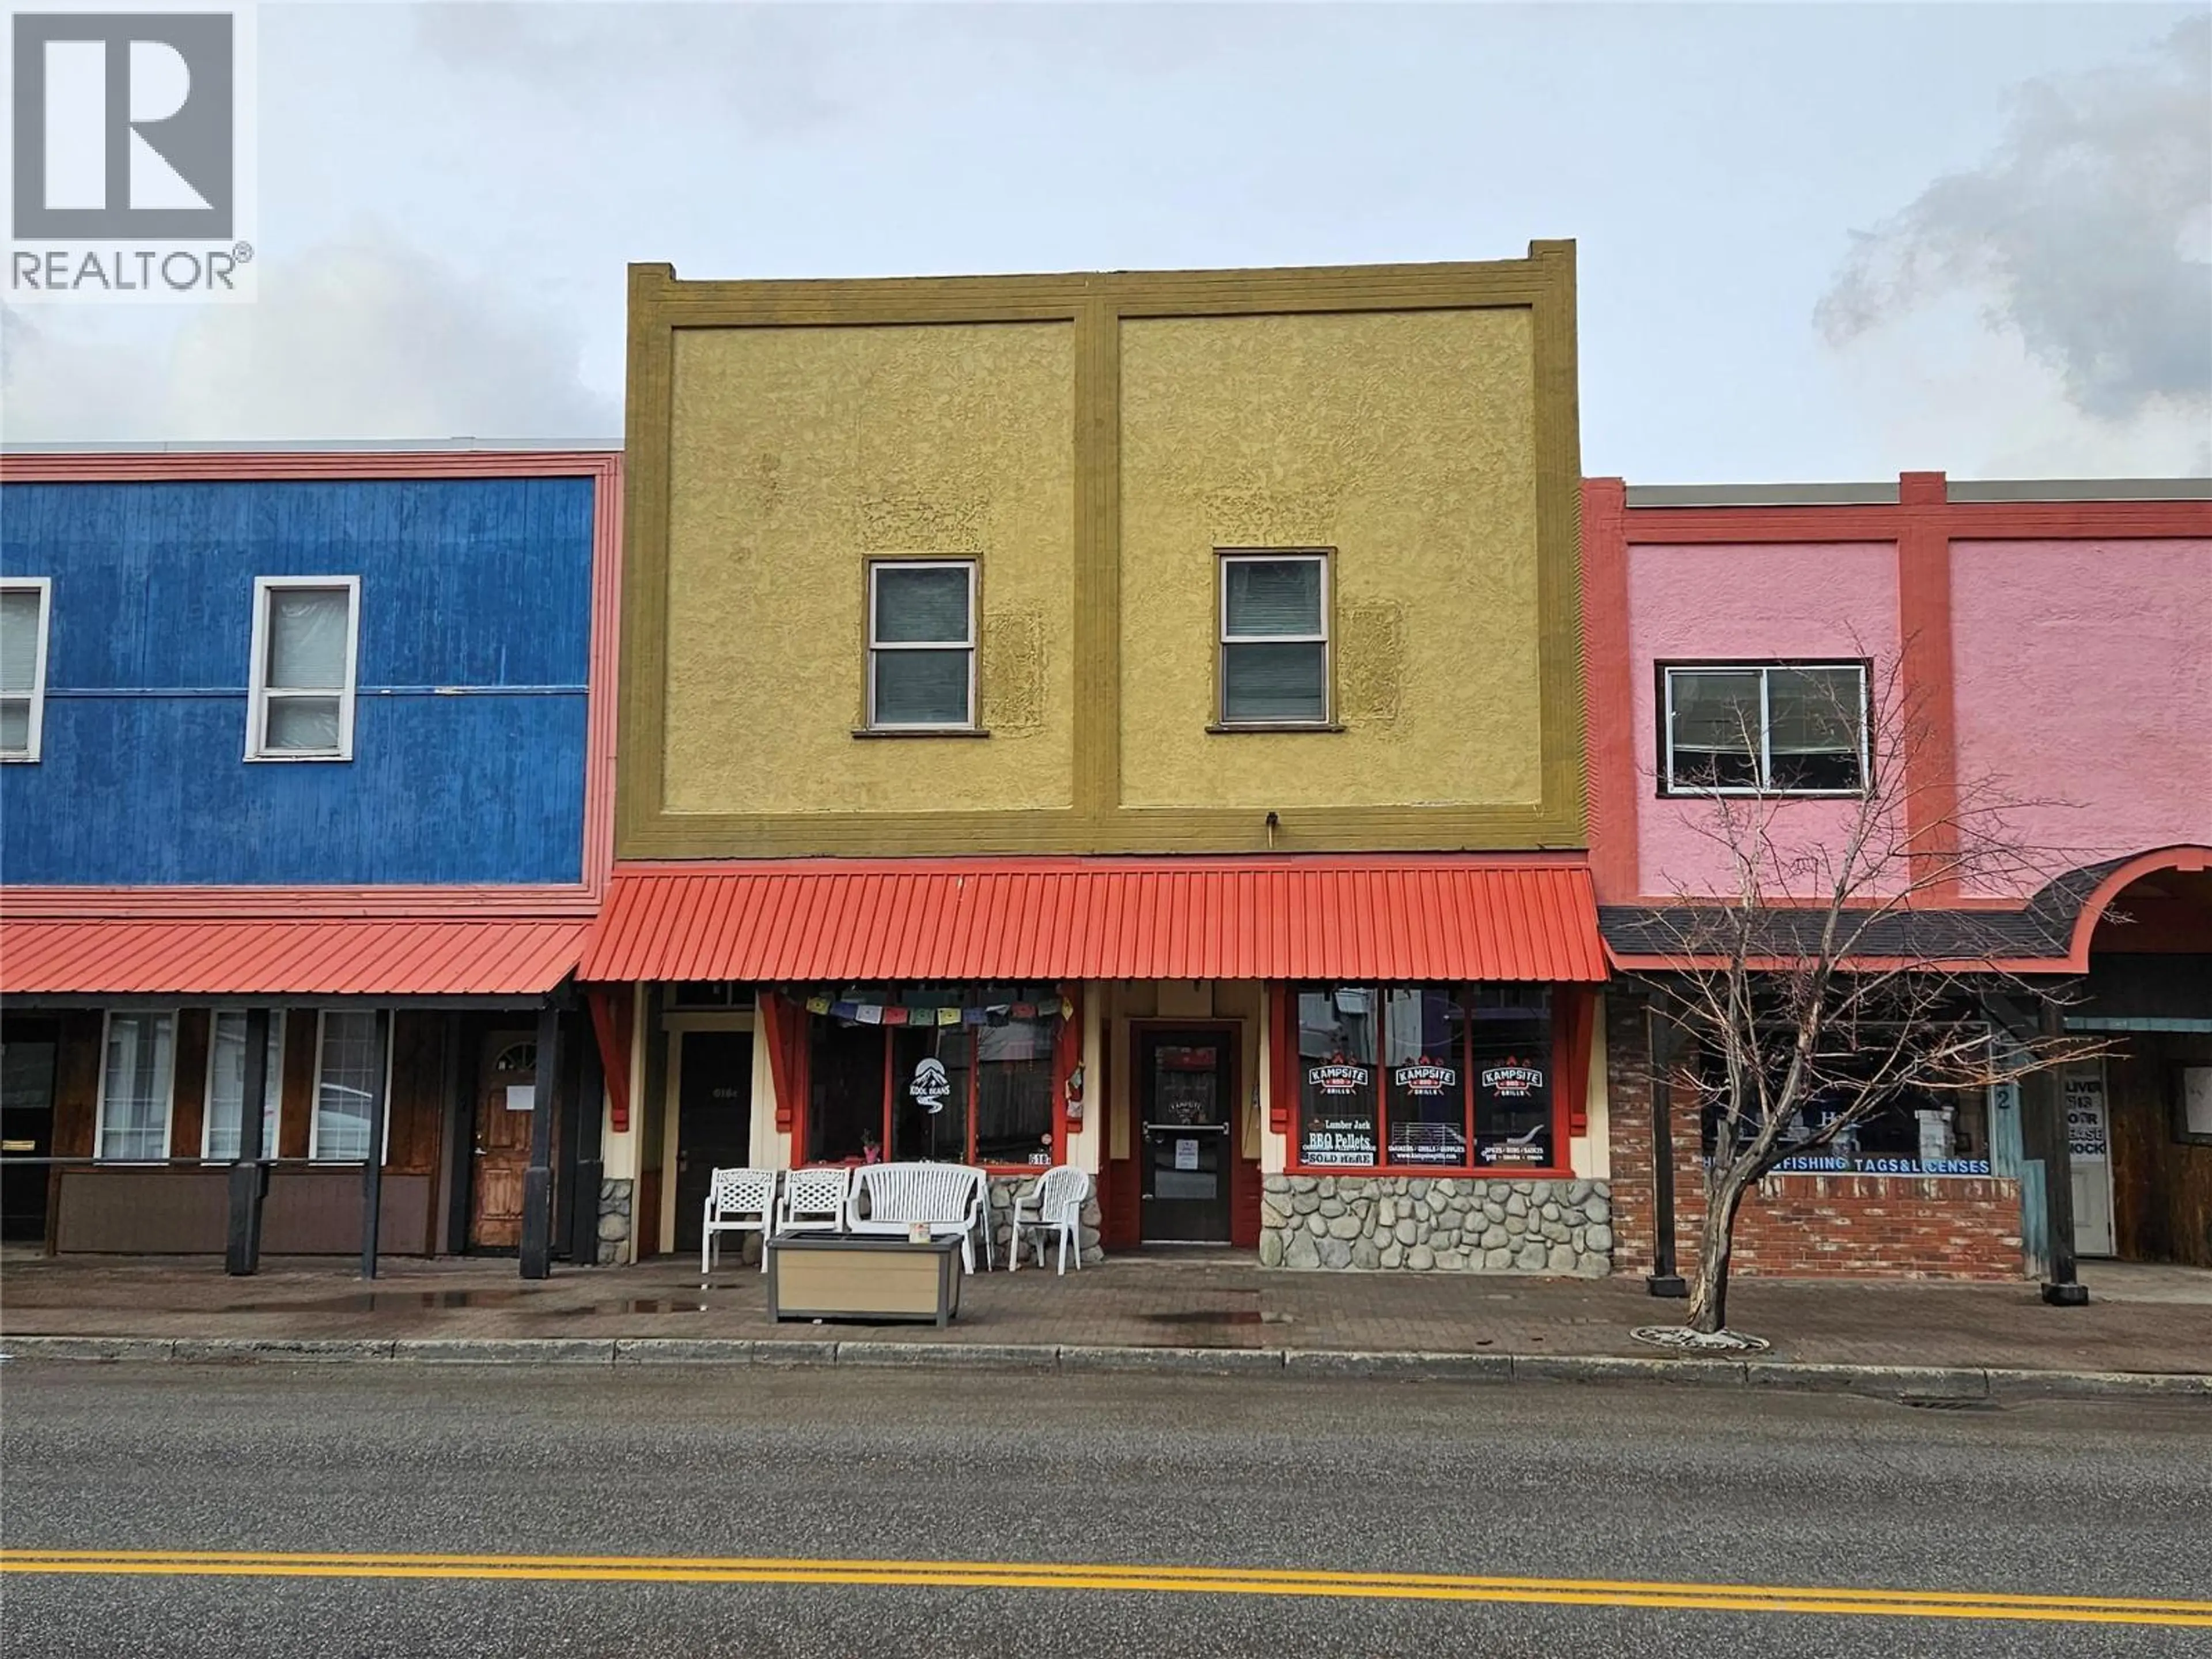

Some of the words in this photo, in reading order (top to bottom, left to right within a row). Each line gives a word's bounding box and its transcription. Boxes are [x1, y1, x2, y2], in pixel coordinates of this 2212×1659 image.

[1311, 1067, 1365, 1081] KAMPSITE
[1399, 1068, 1451, 1082] KAMPSITE
[1485, 1070, 1539, 1084] KAMPSITE
[1325, 1119, 1352, 1130] Lumber
[1354, 1119, 1371, 1130] Jack
[1309, 1132, 1334, 1150] BBQ
[1335, 1132, 1372, 1149] Pellets
[1309, 1154, 1338, 1164] SOLD
[1340, 1154, 1370, 1164] HERE
